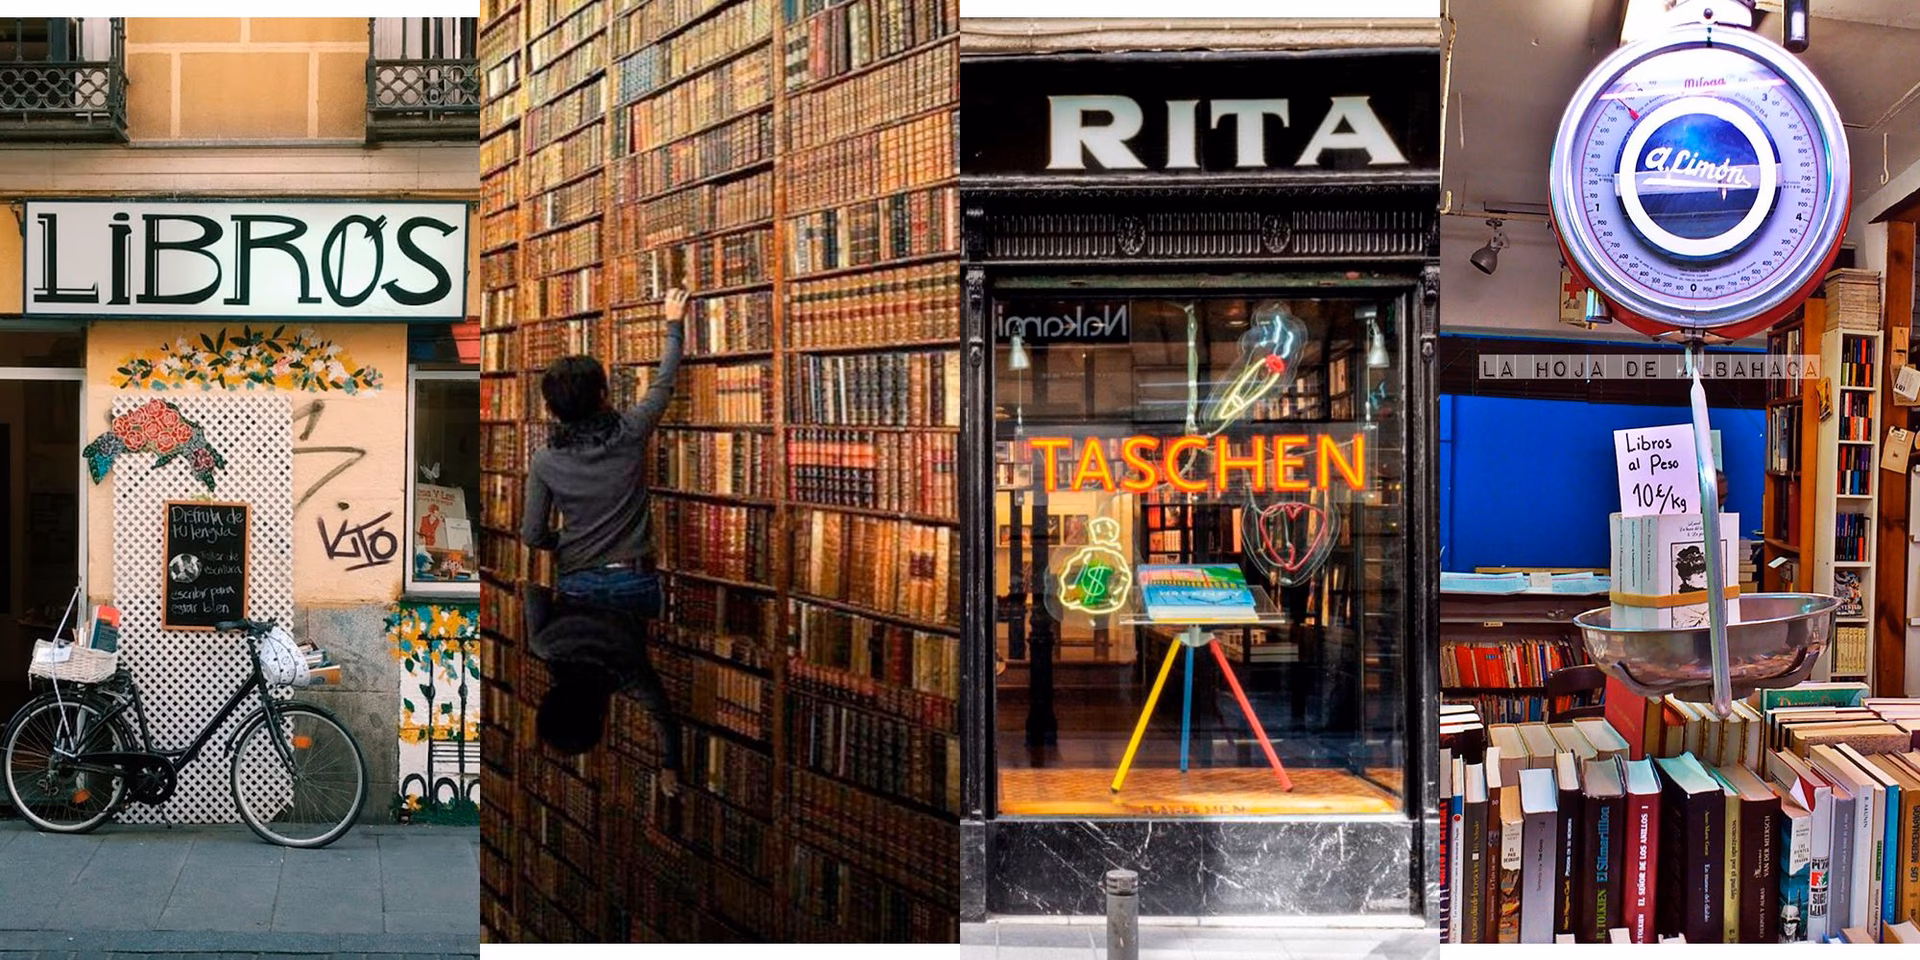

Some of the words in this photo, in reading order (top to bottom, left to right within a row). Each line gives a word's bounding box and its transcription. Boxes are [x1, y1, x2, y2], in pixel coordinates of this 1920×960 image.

[1762, 94, 1768, 102] 3
[1046, 95, 1409, 170] RITA
[1595, 204, 1600, 212] 1
[1796, 213, 1802, 221] 4
[1690, 283, 1697, 292] 0
[1626, 433, 1673, 453] Libros
[1030, 432, 1366, 493] TASCHEN
[1628, 457, 1641, 471] al
[1650, 454, 1680, 475] Peso
[226, 508, 244, 525] de
[191, 526, 237, 544] lengua
[211, 586, 235, 604] para
[202, 601, 230, 614] bien
[1640, 814, 1648, 844] ANILLOS
[1910, 805, 1920, 864] MERCENARIOS
[1597, 806, 1610, 871] Silmarillion
[1639, 846, 1648, 859] LOS
[1638, 861, 1647, 870] DE
[1704, 864, 1710, 873] En
[1597, 872, 1608, 883] El
[1910, 867, 1918, 882] LOS
[1637, 872, 1646, 896] SEÑOR
[1597, 890, 1607, 928] TOLKIEN
[1638, 897, 1646, 906] EL
